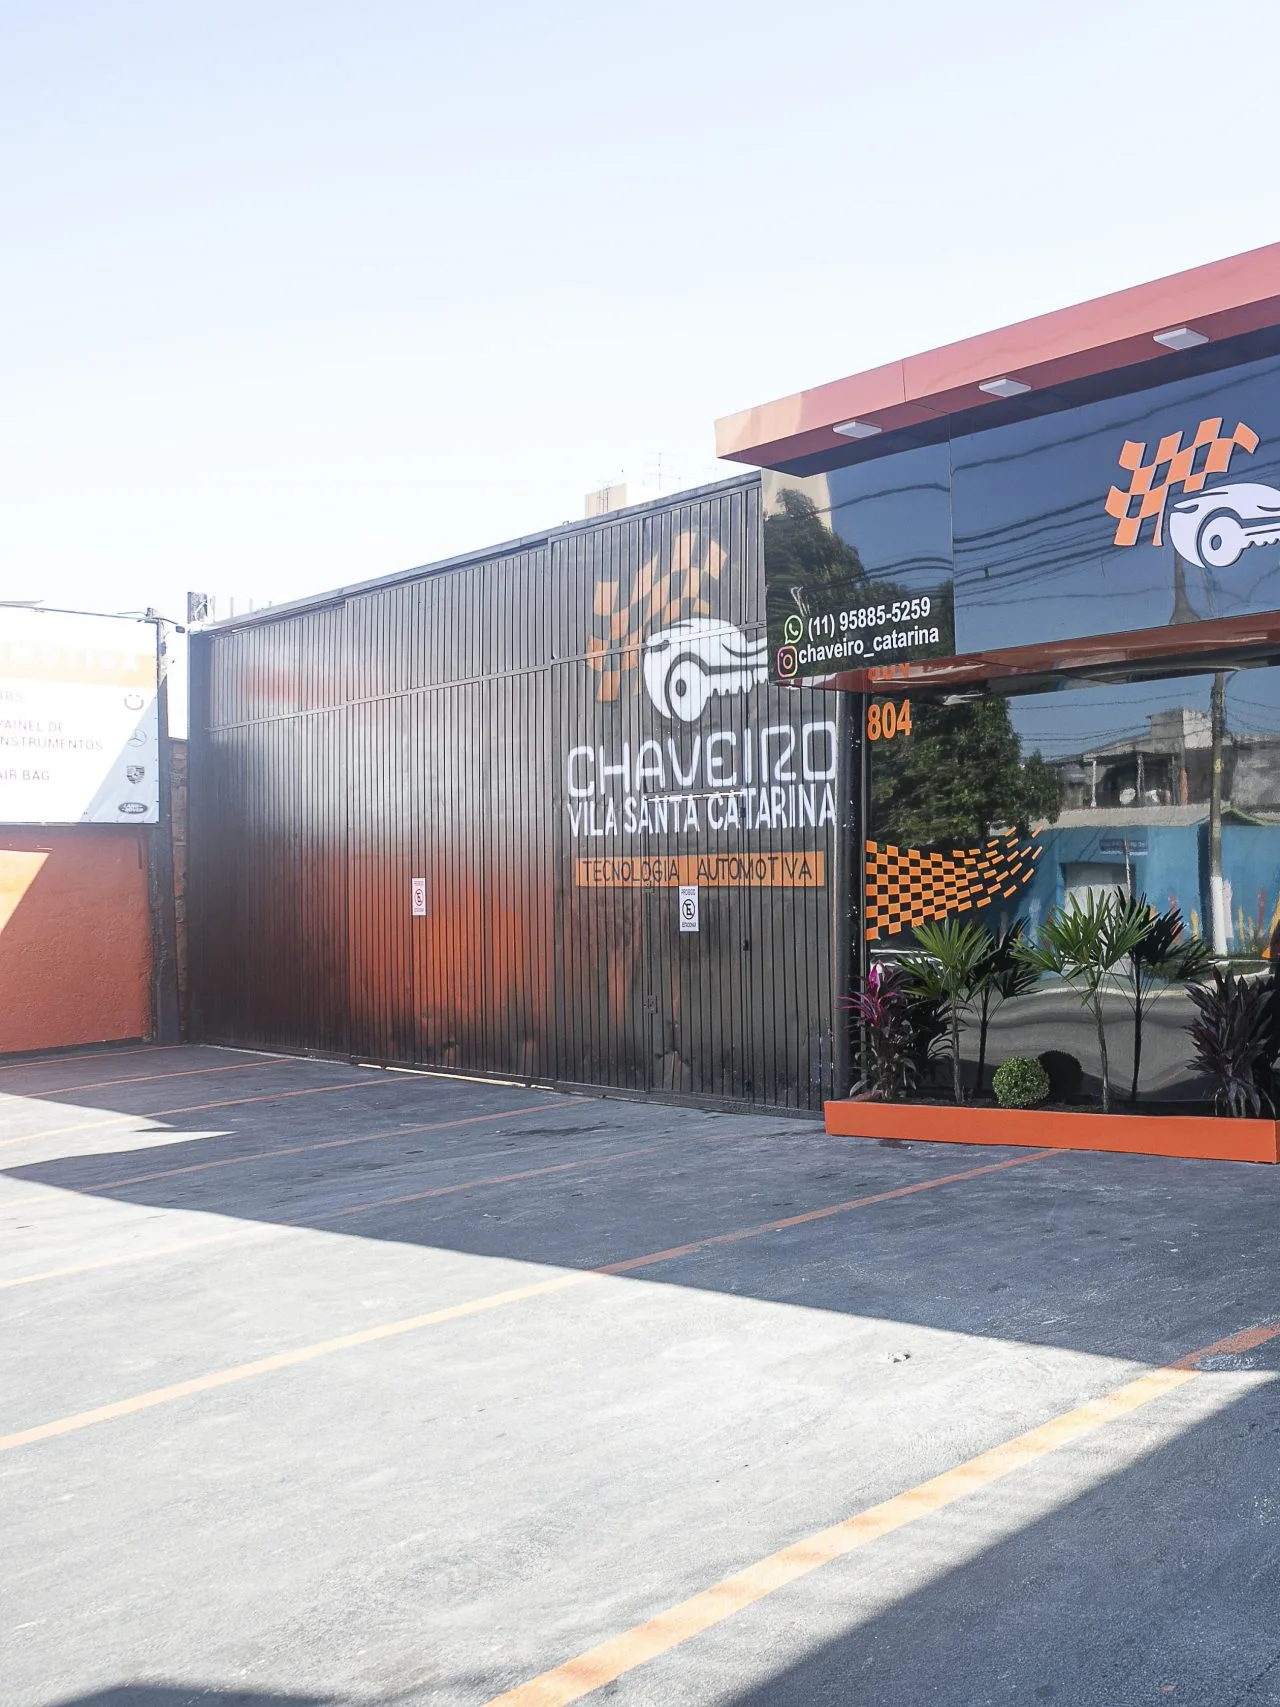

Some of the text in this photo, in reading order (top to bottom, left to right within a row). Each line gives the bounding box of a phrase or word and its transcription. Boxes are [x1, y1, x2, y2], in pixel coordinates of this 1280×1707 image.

[808, 596, 931, 641] (11) 95885-5259
[798, 625, 939, 664] chaveiro_catarina
[867, 699, 912, 741] 804
[22, 769, 50, 781] BAG
[567, 721, 837, 798] CHAVEIRO
[567, 782, 837, 837] VILA SANTA CATARINA
[582, 856, 812, 883] TECNOLOGIA AUTOMOTIVA
